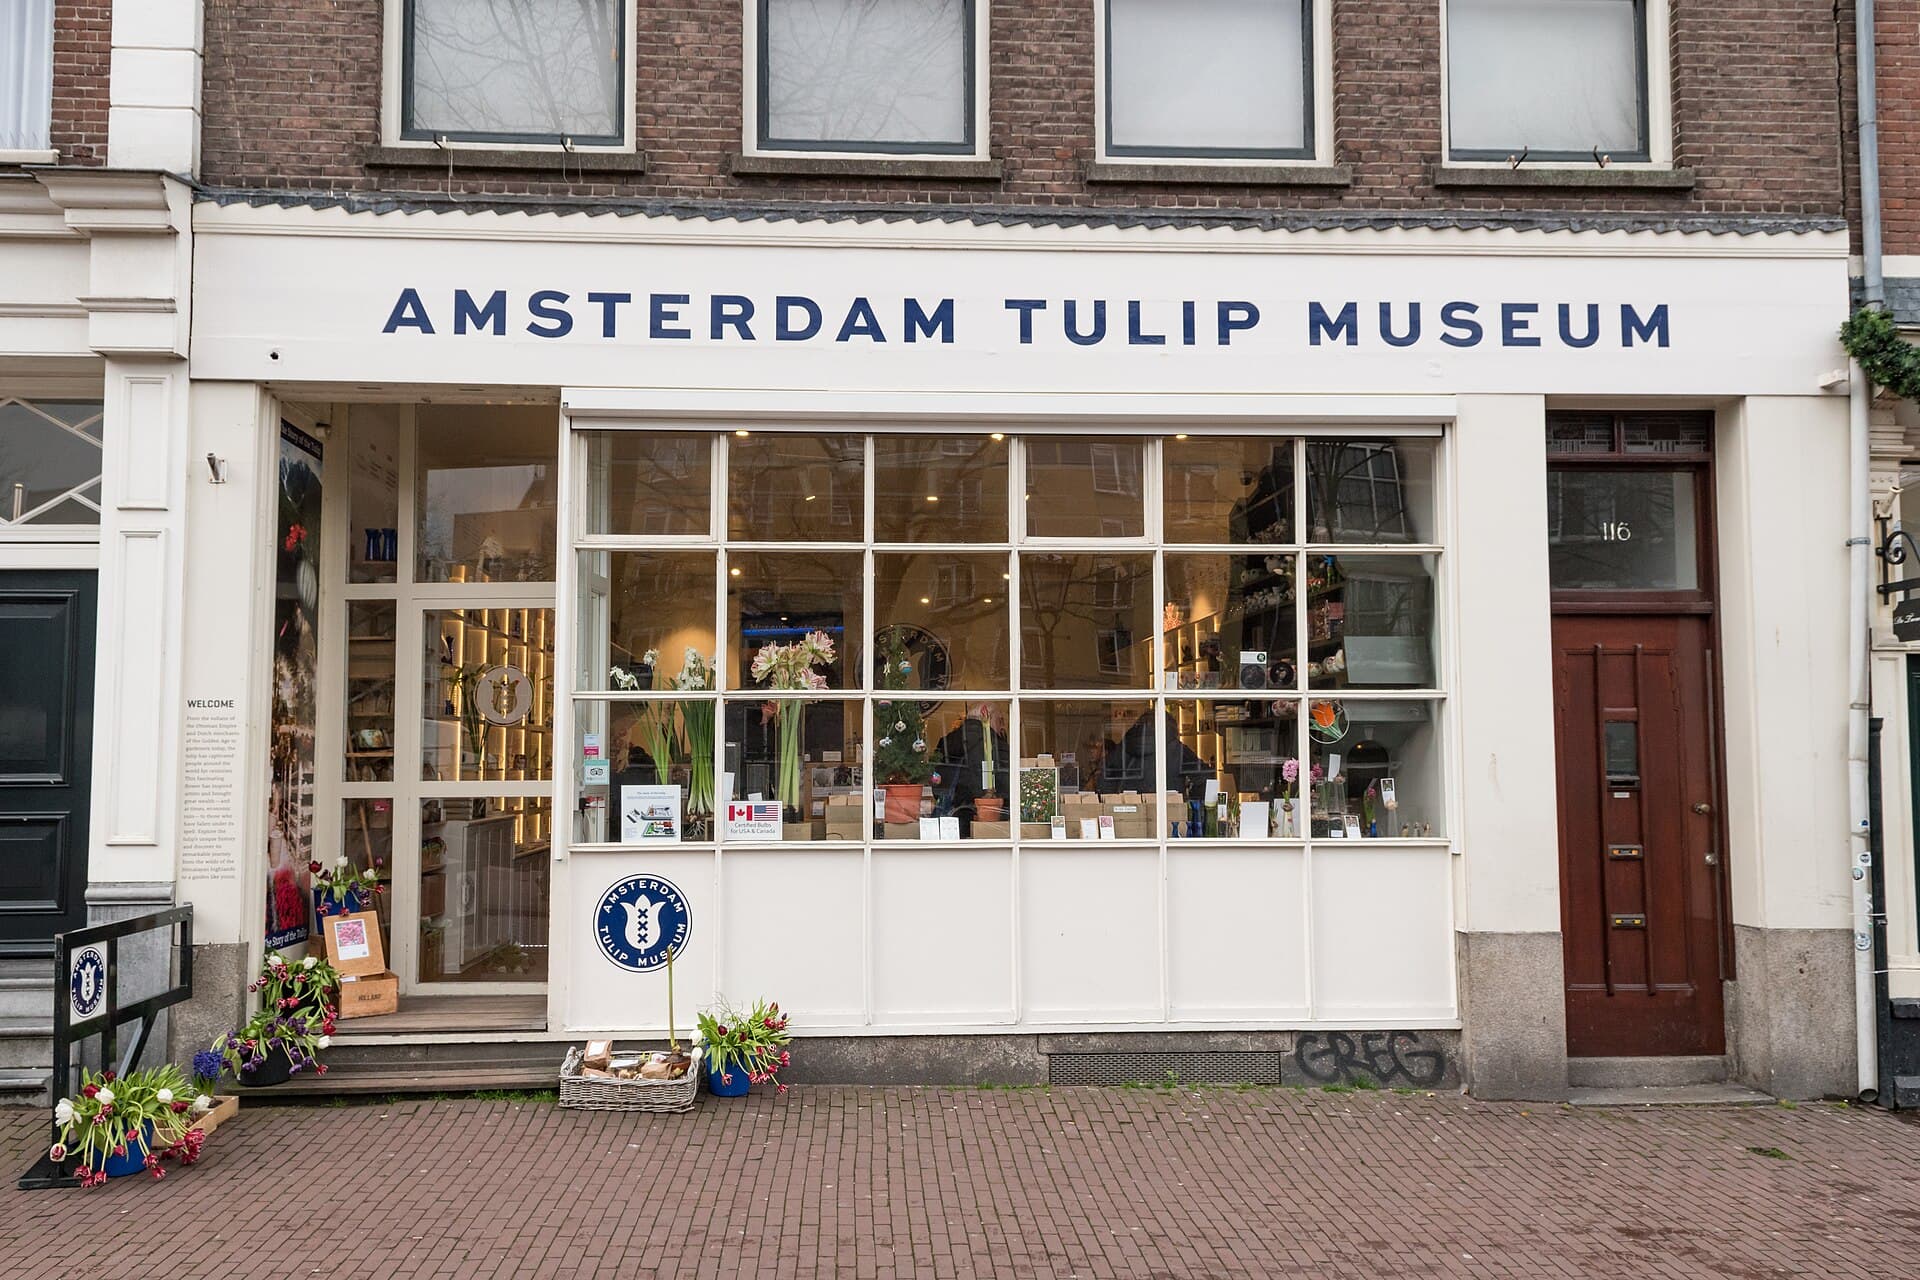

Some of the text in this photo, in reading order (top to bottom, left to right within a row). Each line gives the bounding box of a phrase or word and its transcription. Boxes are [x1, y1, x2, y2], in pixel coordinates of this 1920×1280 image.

[381, 287, 1670, 349] AMSTERDAM TULIP MUSEUM
[1603, 521, 1631, 541] 116
[187, 699, 234, 708] WELCOME
[603, 880, 684, 914] AMSTERDAM
[600, 925, 629, 961] TULIP
[73, 950, 103, 980] AMSTERDAM
[72, 987, 83, 1011] TULIP
